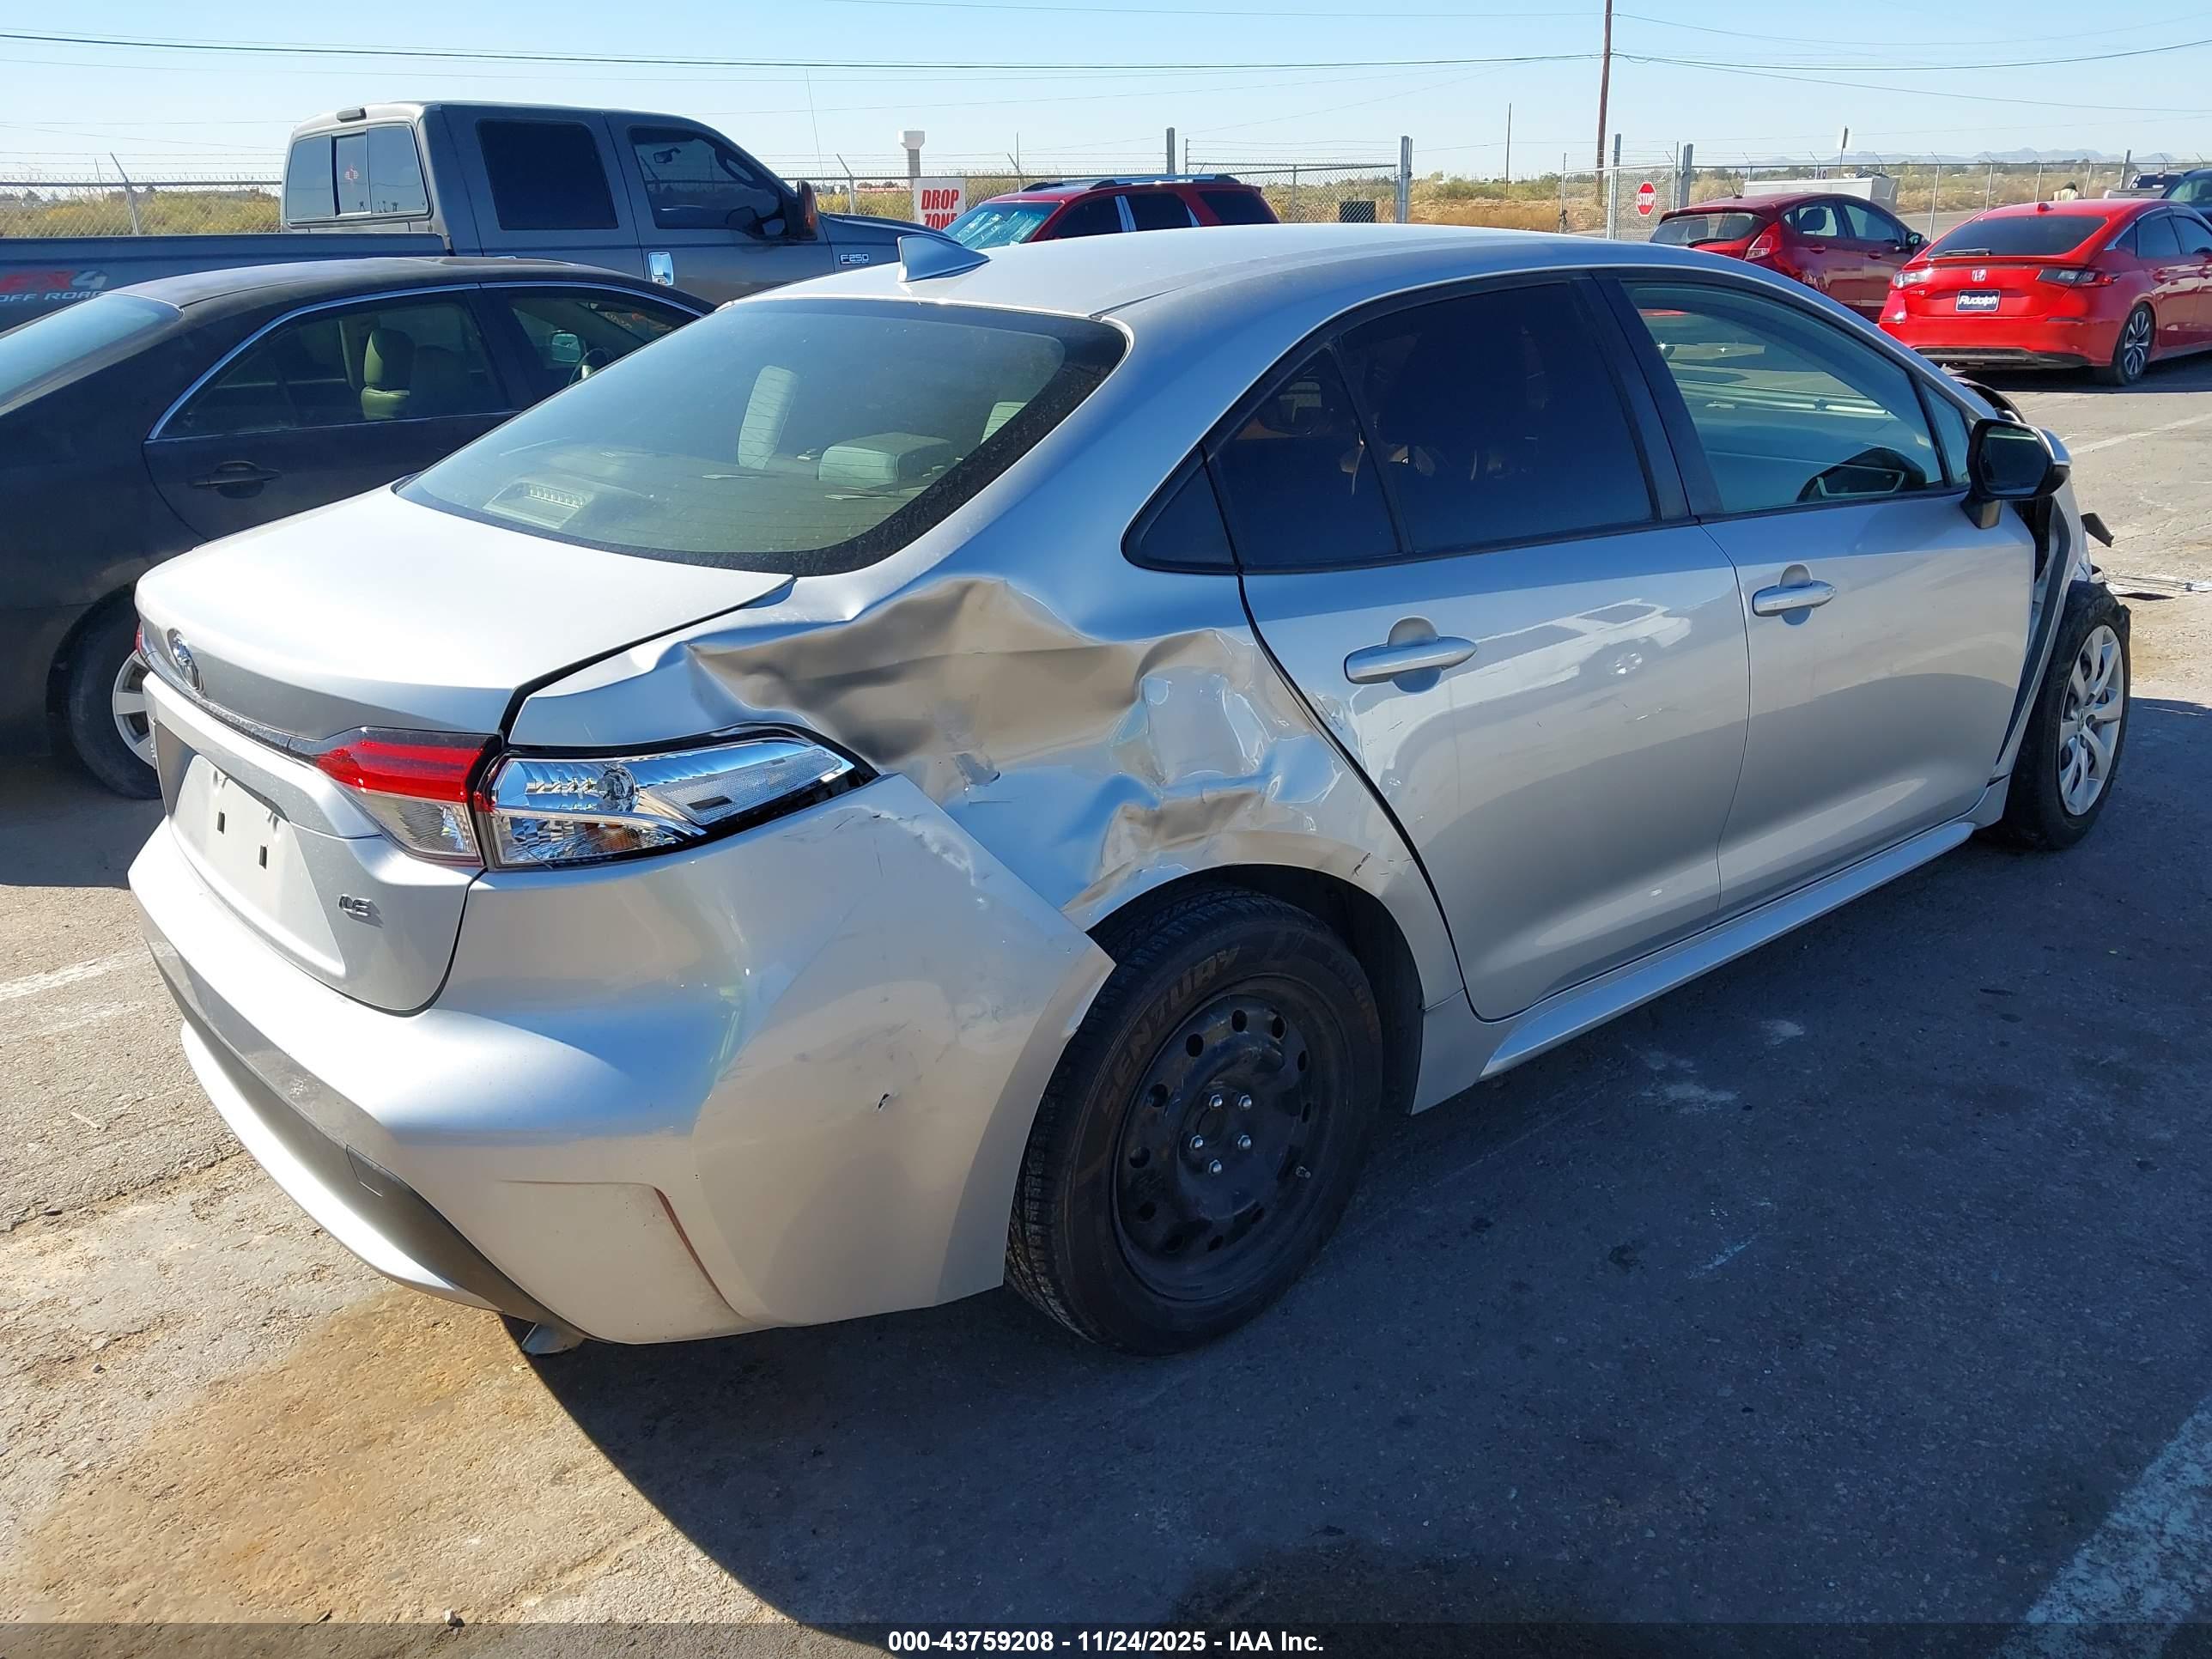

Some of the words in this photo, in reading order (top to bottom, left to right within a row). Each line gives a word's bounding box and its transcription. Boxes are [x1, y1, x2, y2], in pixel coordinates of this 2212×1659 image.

[921, 189, 959, 210] DROP
[1638, 192, 1655, 206] STOP
[840, 253, 869, 262] F250
[1959, 295, 1997, 306] Rudolph
[338, 894, 371, 917] LE
